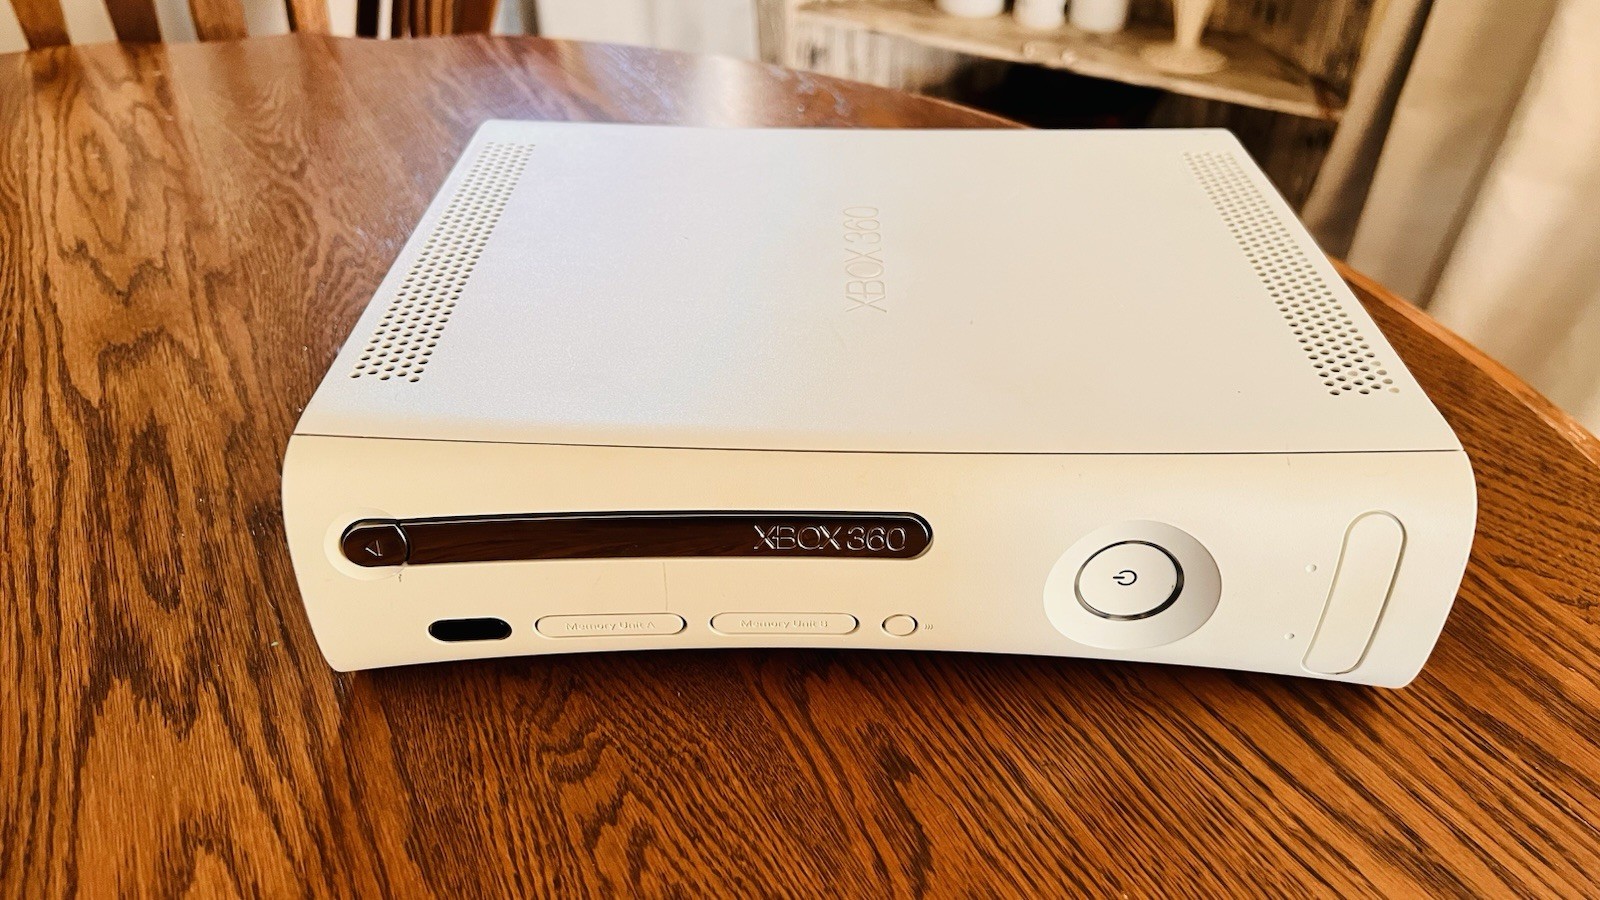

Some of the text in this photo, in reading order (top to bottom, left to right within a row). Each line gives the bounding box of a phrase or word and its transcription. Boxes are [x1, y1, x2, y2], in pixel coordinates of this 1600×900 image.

[843, 206, 887, 313] XBOX 360
[753, 525, 906, 551] XBOX 360
[565, 620, 656, 631] Memory Unit A
[740, 619, 829, 629] Memory Unit B
